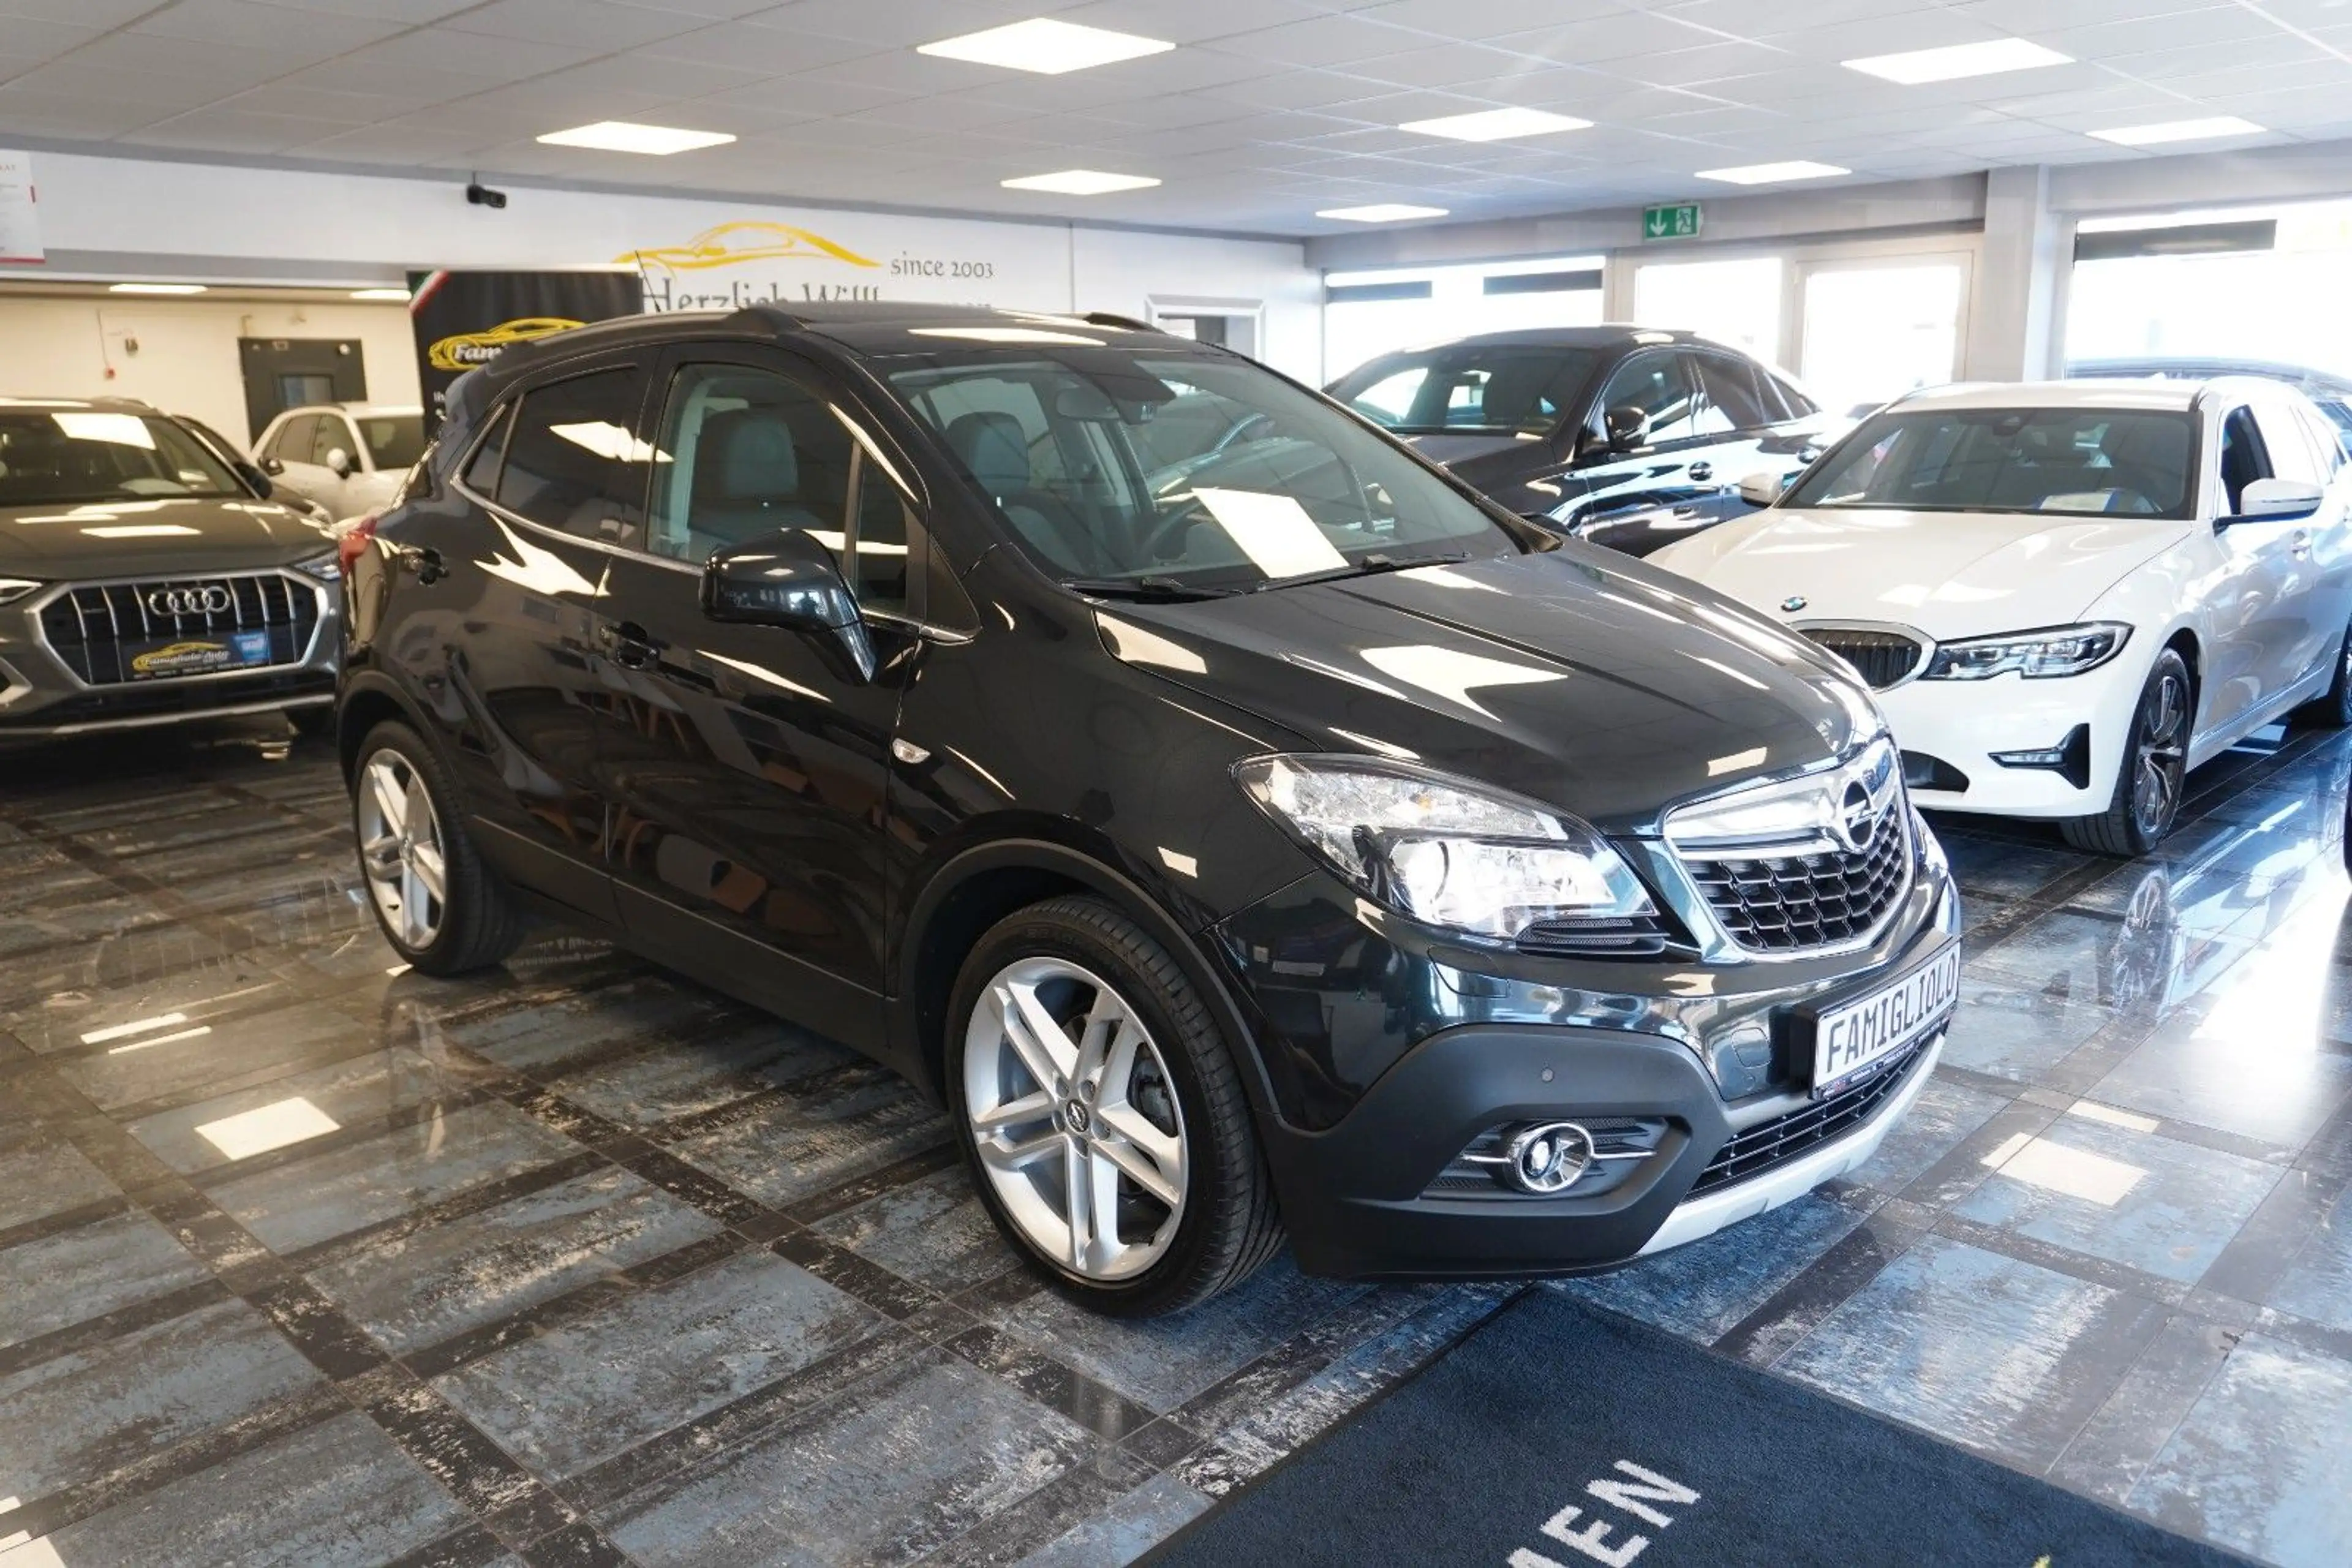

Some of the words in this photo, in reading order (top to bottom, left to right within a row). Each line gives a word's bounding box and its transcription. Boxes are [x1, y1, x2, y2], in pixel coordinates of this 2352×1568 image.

[890, 250, 945, 277] since
[951, 261, 995, 278] 2003
[1826, 951, 1956, 1074] FAMIGLIOLO
